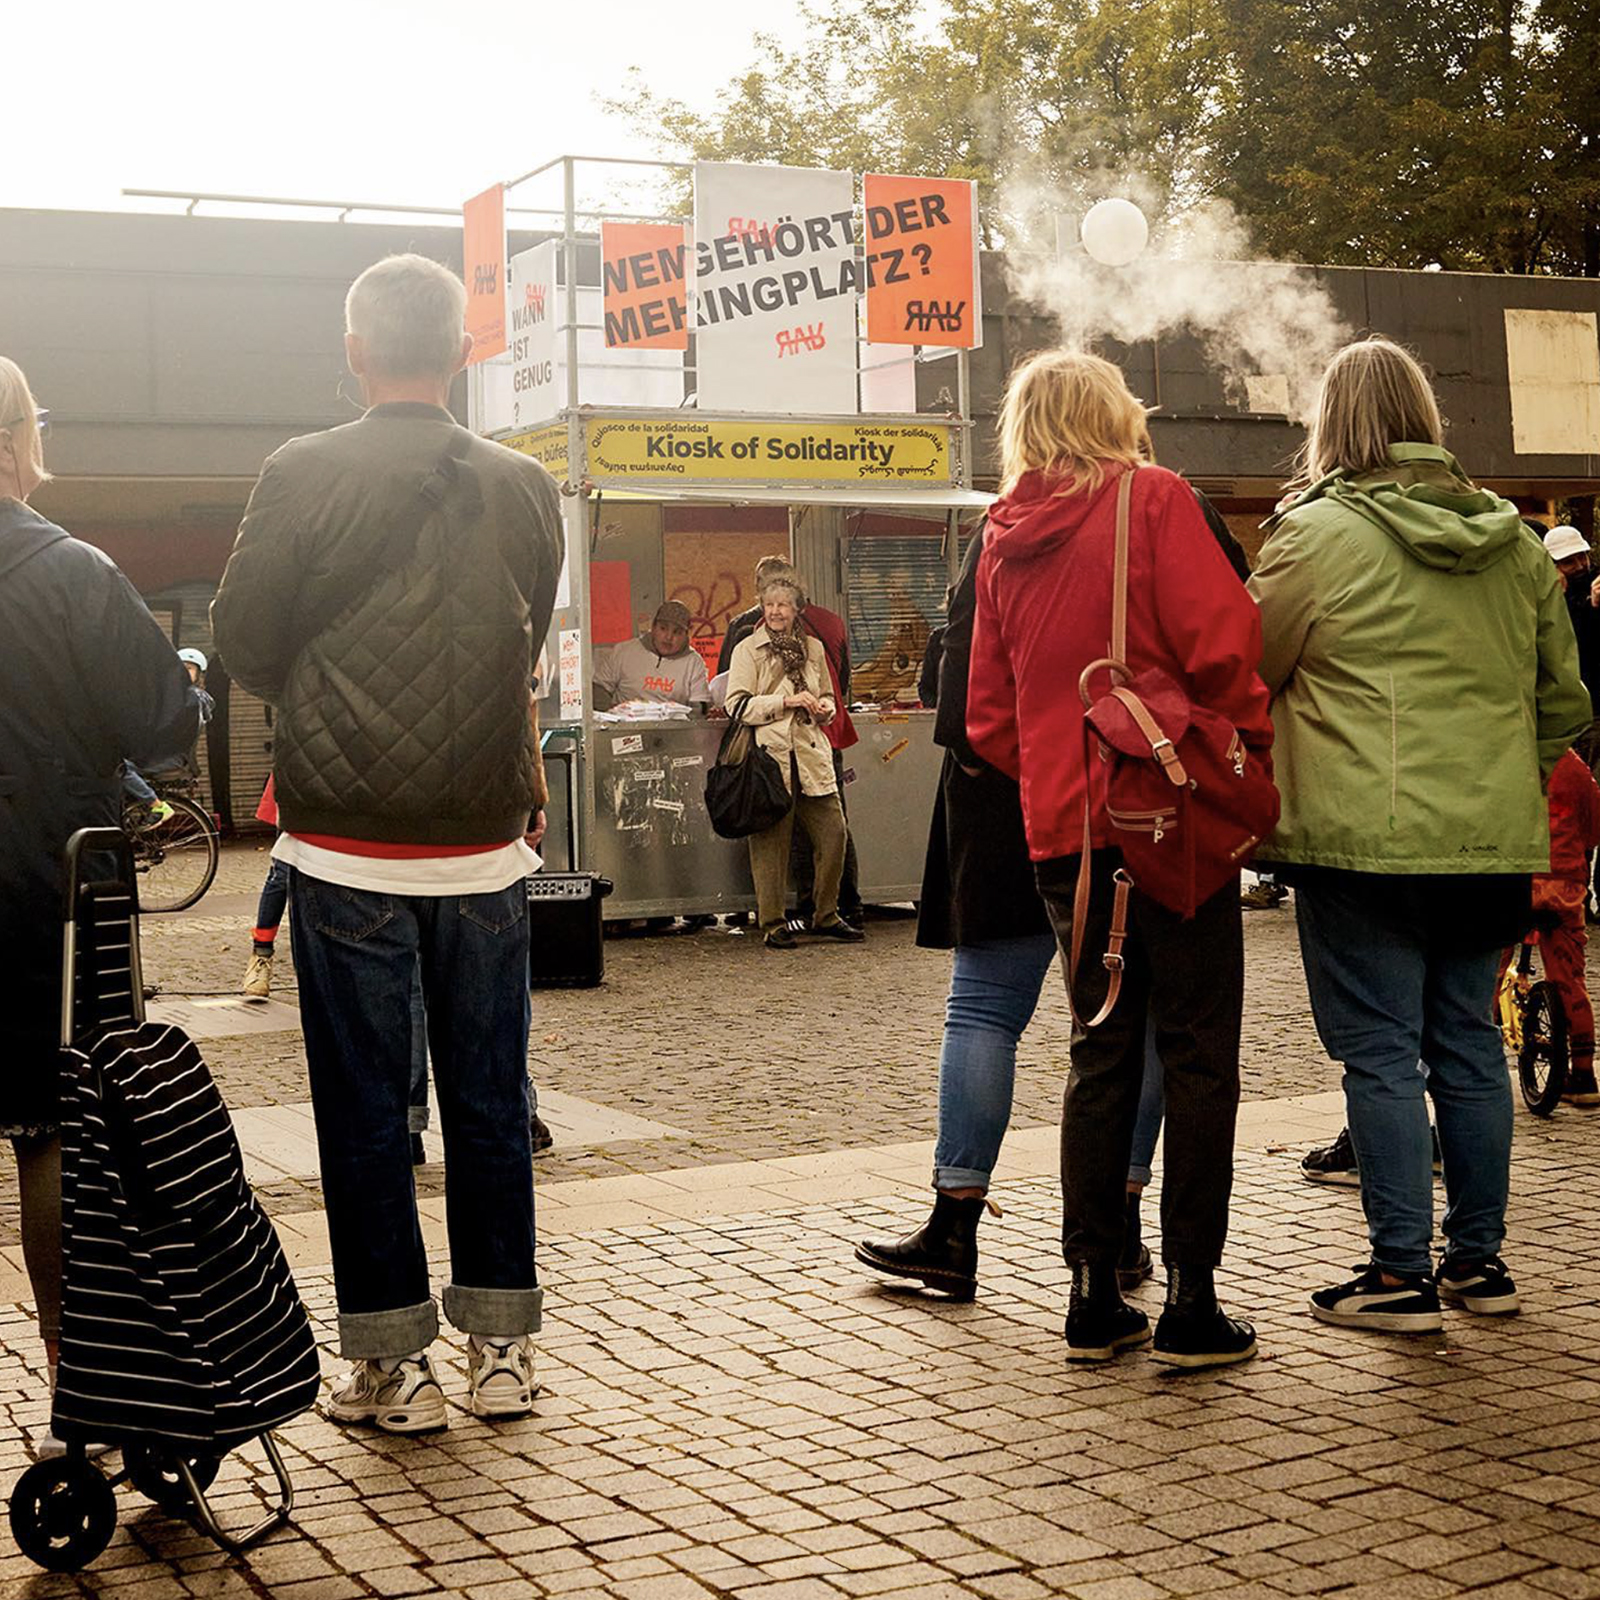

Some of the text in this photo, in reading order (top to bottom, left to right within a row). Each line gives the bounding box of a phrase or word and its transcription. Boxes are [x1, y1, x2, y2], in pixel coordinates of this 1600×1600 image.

[697, 210, 854, 277] GEHÖRT
[866, 194, 951, 239] DER
[512, 299, 545, 332] WANN
[513, 336, 530, 363] IST
[513, 360, 552, 393] GENUG
[513, 402, 520, 423] ?
[592, 423, 709, 449] Quiosco de la solidaridad
[647, 433, 895, 466] Kiosk of Solidarity
[854, 427, 943, 452] Kiosk der Solidarität
